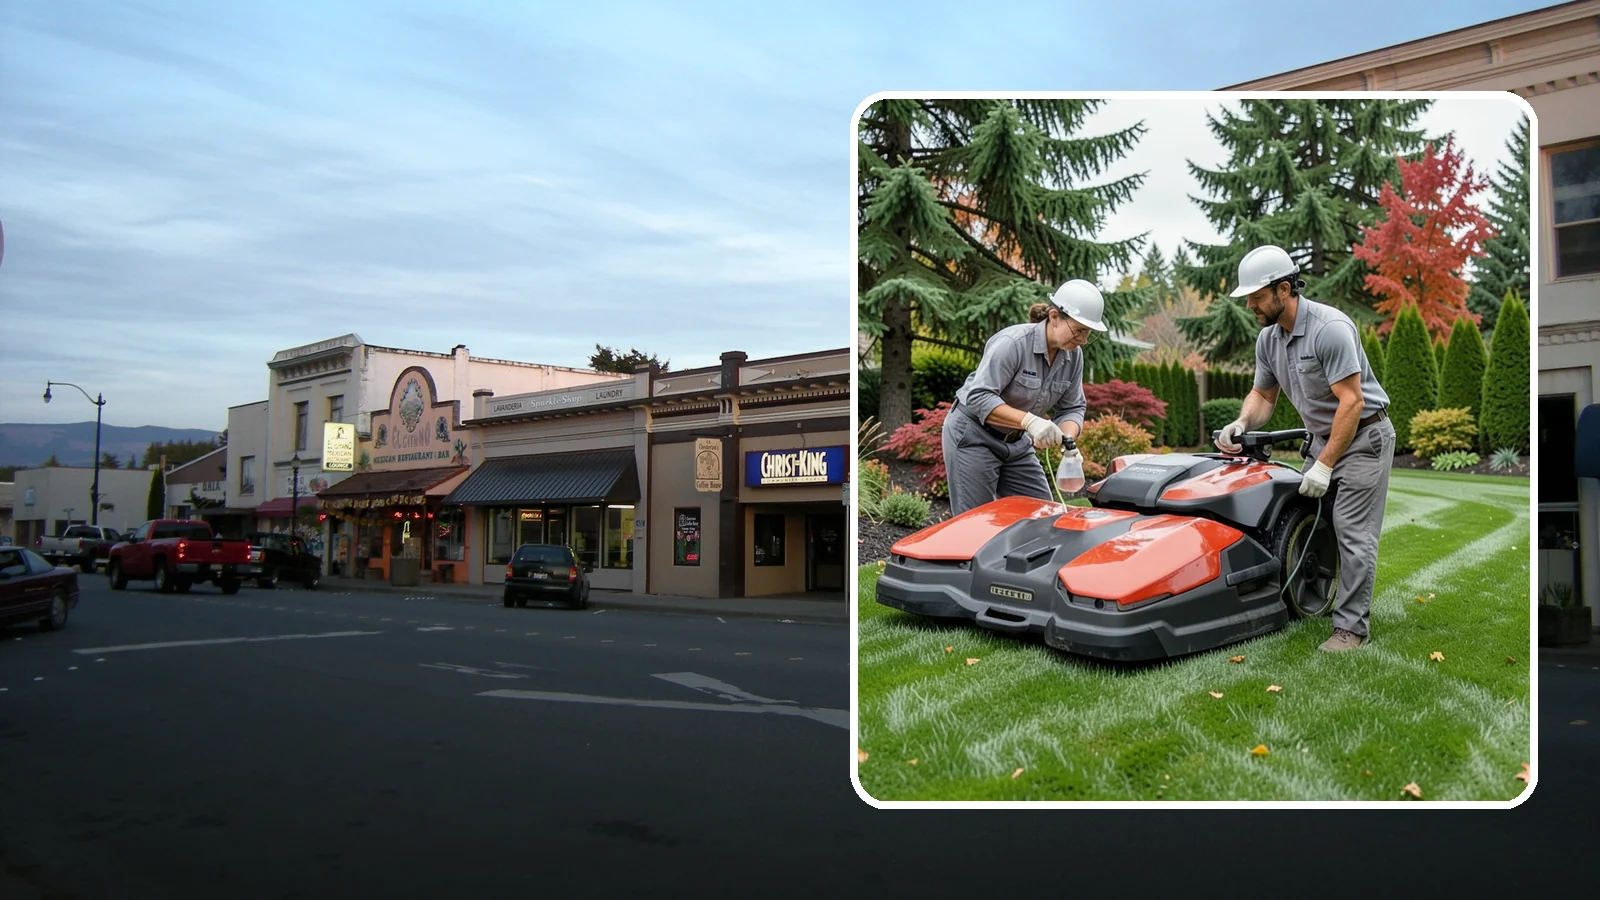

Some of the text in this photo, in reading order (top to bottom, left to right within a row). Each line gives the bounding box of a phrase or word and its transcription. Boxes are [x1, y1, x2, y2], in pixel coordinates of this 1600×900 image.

[494, 389, 624, 413] LAVANDERIA Sparkle Shop LAUNDRY
[373, 454, 396, 464] MEXICAN
[397, 451, 433, 462] RESTAURANT
[438, 450, 450, 459] BAR
[760, 450, 827, 478] CHRIST KING
[710, 481, 722, 489] House
